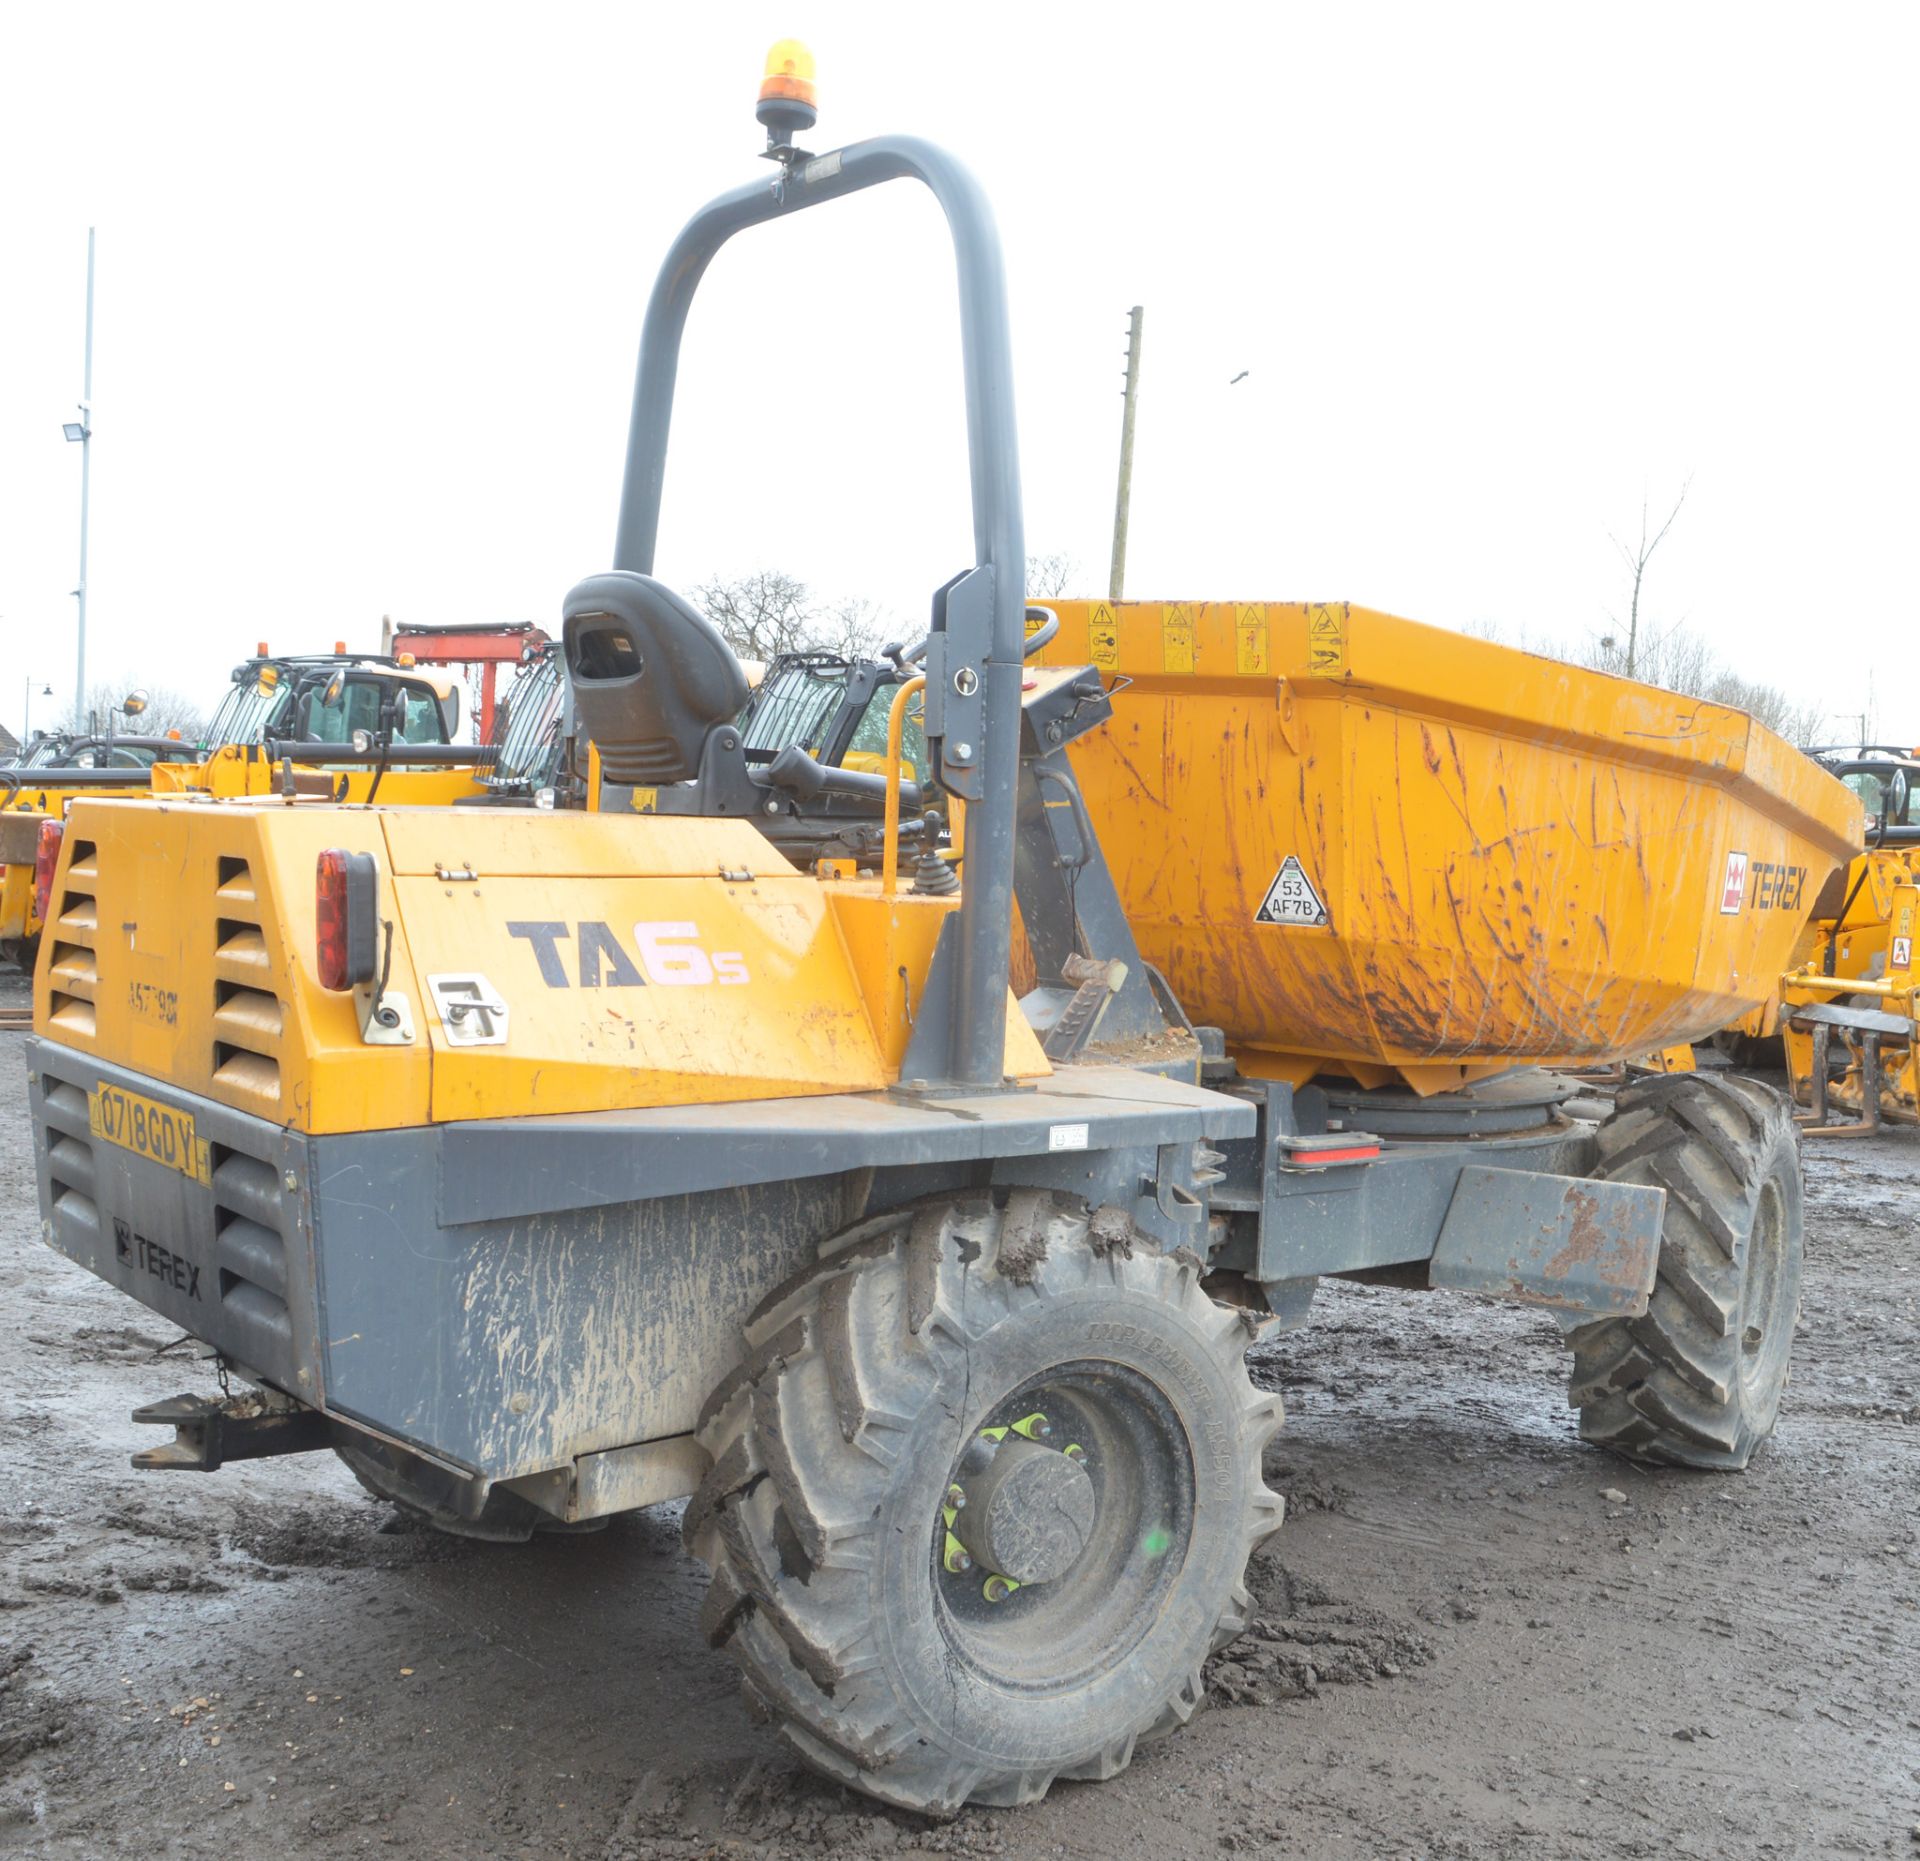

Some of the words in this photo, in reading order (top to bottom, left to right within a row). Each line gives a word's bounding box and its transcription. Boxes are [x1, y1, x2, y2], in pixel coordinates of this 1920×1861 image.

[1282, 880, 1303, 897] 53
[1750, 862, 1807, 911] TEREX
[1272, 898, 1313, 916] AF7B
[134, 1233, 202, 1302] TEREX
